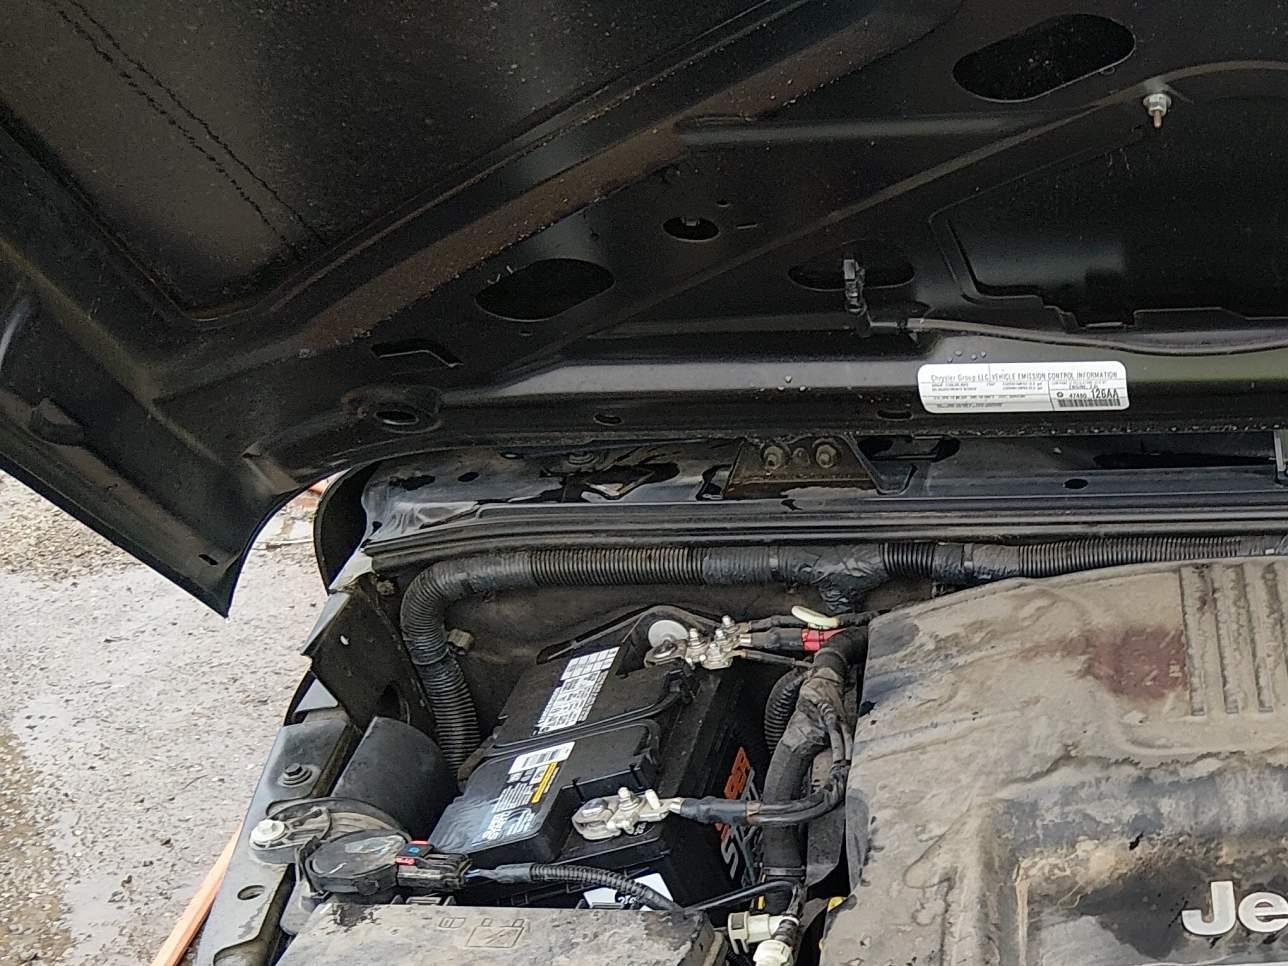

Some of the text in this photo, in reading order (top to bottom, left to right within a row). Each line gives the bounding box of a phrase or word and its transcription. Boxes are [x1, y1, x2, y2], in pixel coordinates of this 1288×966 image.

[957, 373, 976, 382] Group
[991, 372, 1015, 381] VEHICLE
[1017, 372, 1046, 381] EMISSION
[1048, 372, 1073, 380] CONTROL
[1076, 371, 1118, 379] INFORMATION
[1091, 388, 1119, 399] 126AA
